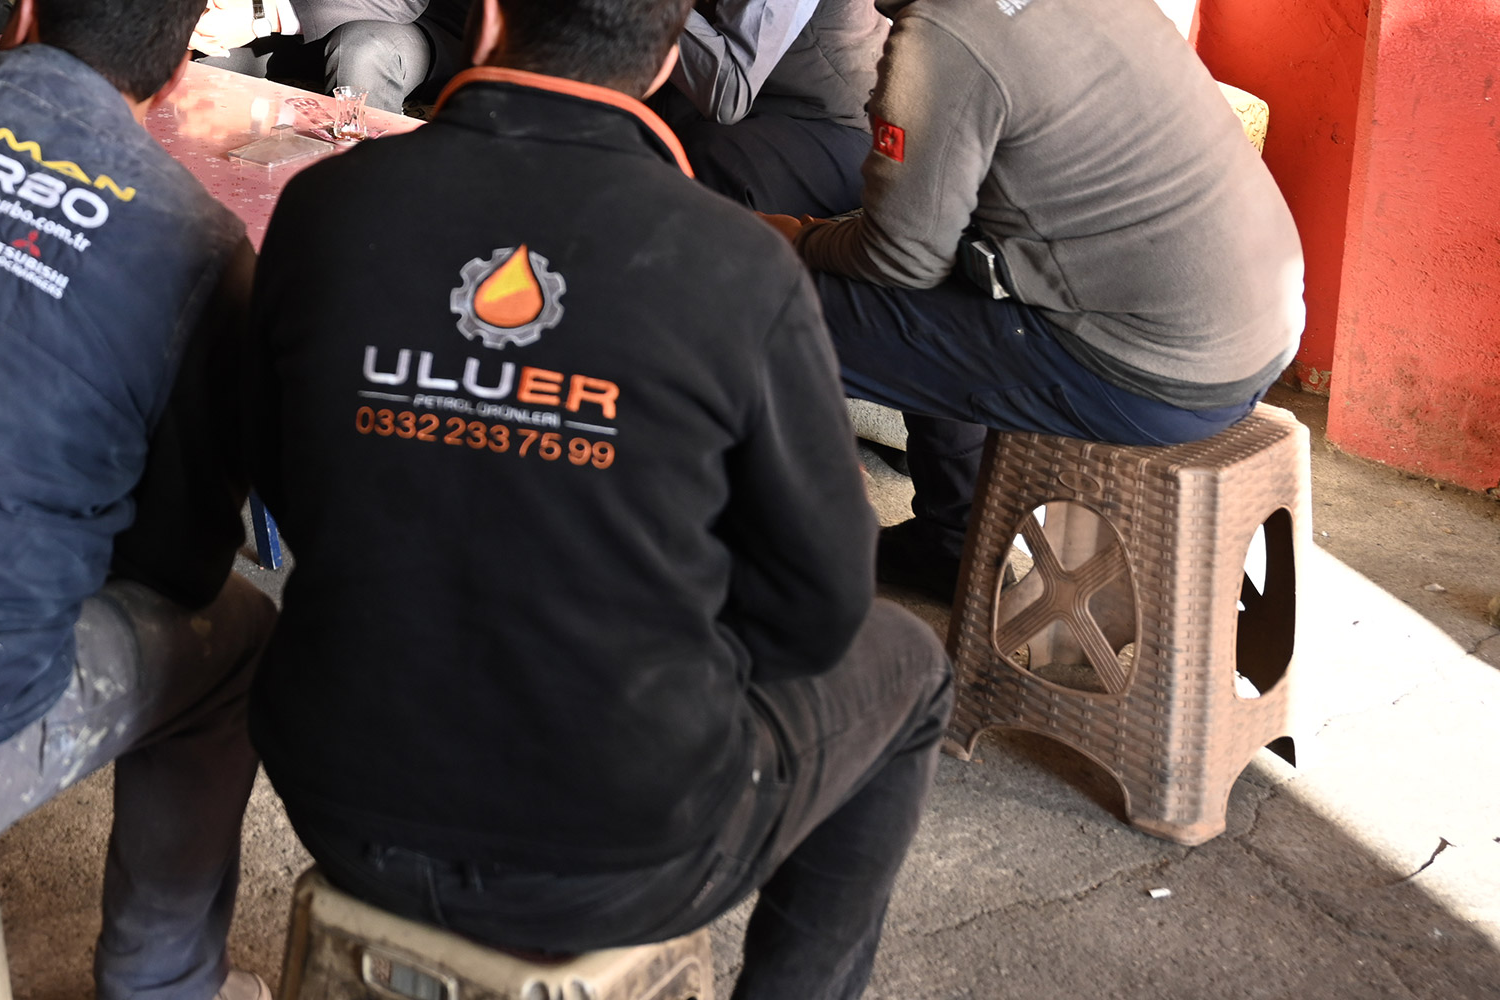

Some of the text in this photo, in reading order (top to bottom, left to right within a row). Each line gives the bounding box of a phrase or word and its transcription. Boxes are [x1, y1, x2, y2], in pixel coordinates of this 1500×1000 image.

[363, 345, 620, 419] ULUER
[413, 393, 475, 415] PETROL
[356, 406, 616, 470] 0332 233 75 99
